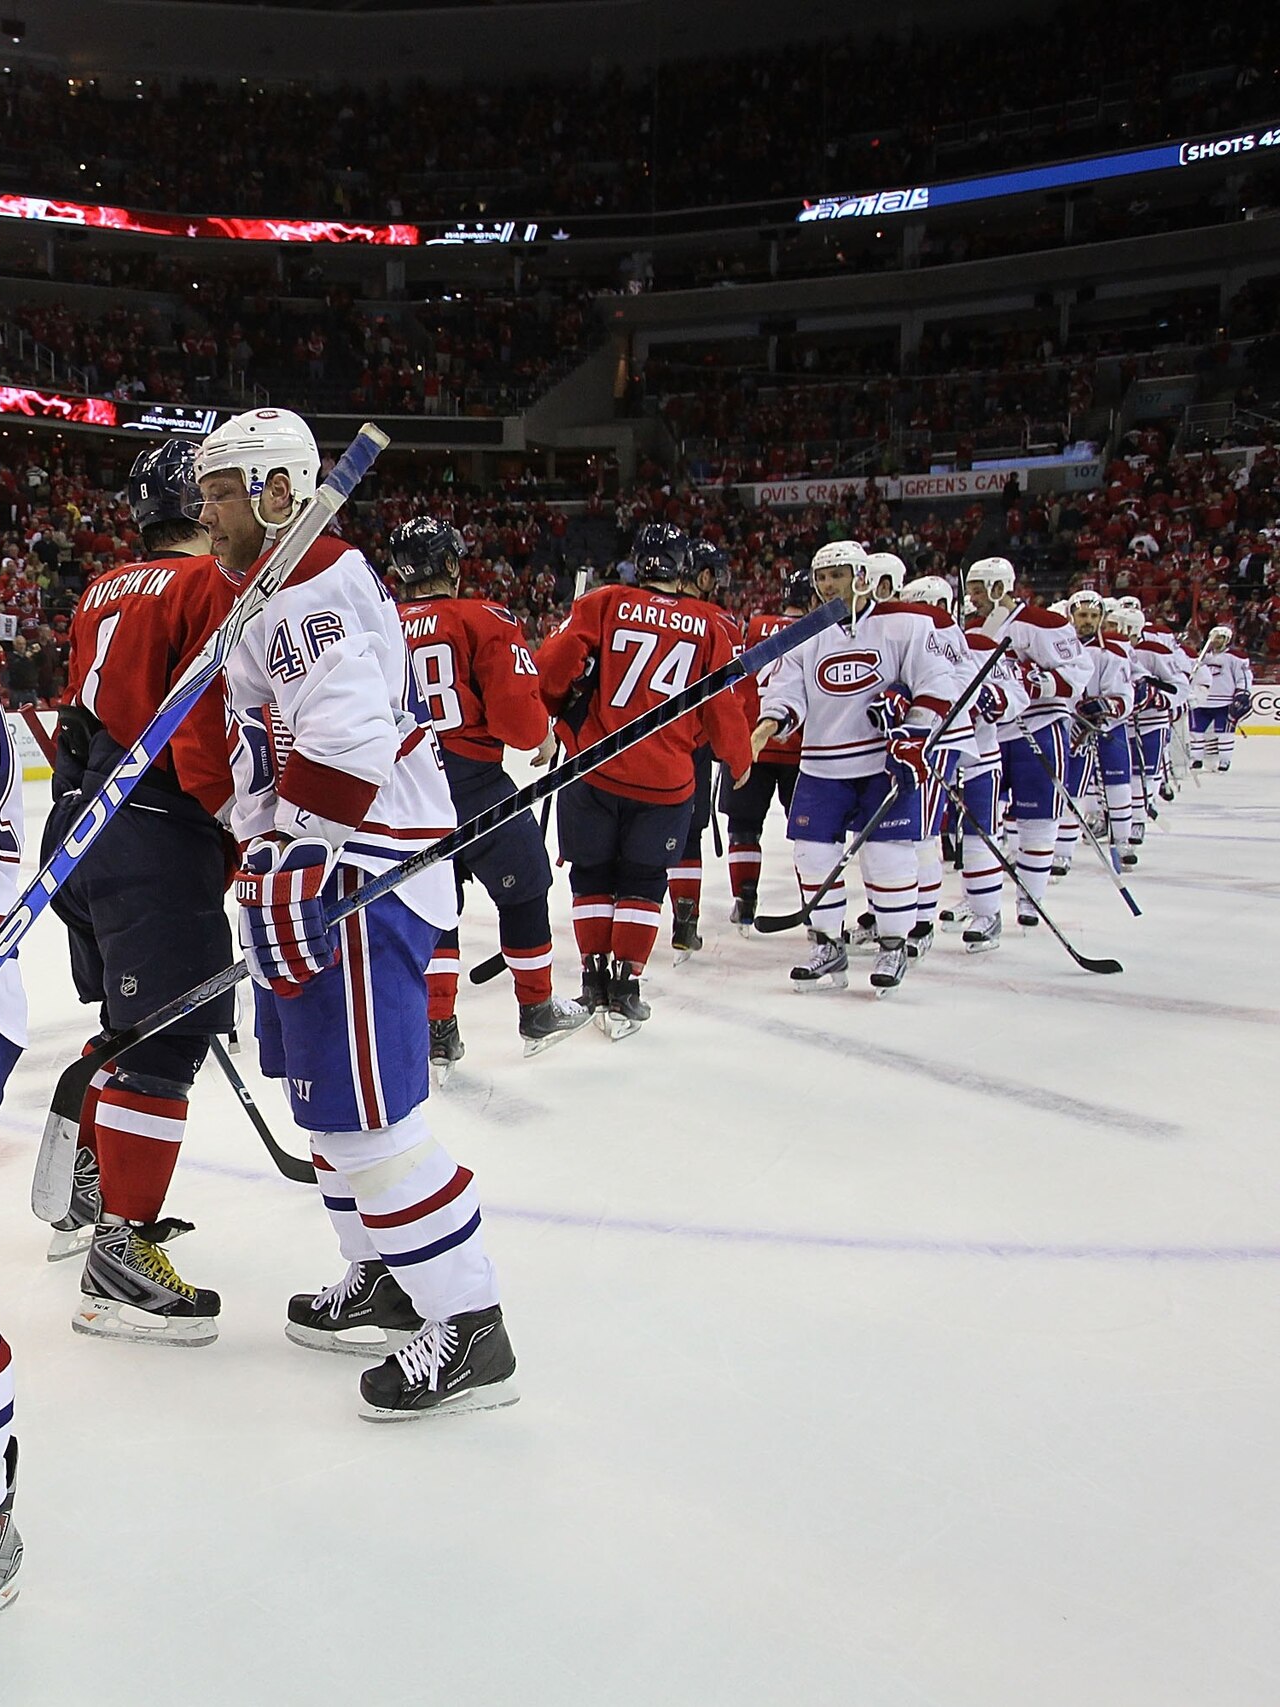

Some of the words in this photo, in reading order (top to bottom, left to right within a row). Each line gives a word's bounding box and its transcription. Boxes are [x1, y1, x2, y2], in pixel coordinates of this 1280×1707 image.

[445, 231, 501, 241] WASHINGTON
[141, 413, 202, 430] WASHINGTON
[1074, 465, 1099, 478] 107
[140, 483, 149, 499] 8
[760, 485, 798, 502] OVI'S
[905, 477, 967, 497] GREEN'S
[974, 474, 1013, 491] GAN
[401, 564, 416, 575] 28
[648, 557, 660, 567] 74
[401, 615, 438, 639] MIN
[618, 602, 708, 638] CARLSON
[761, 622, 787, 638] LA
[266, 610, 346, 684] 46
[511, 643, 539, 675] 28
[611, 629, 698, 708] 74
[348, 1307, 373, 1319] BAUER
[447, 1369, 472, 1390] BAUER
